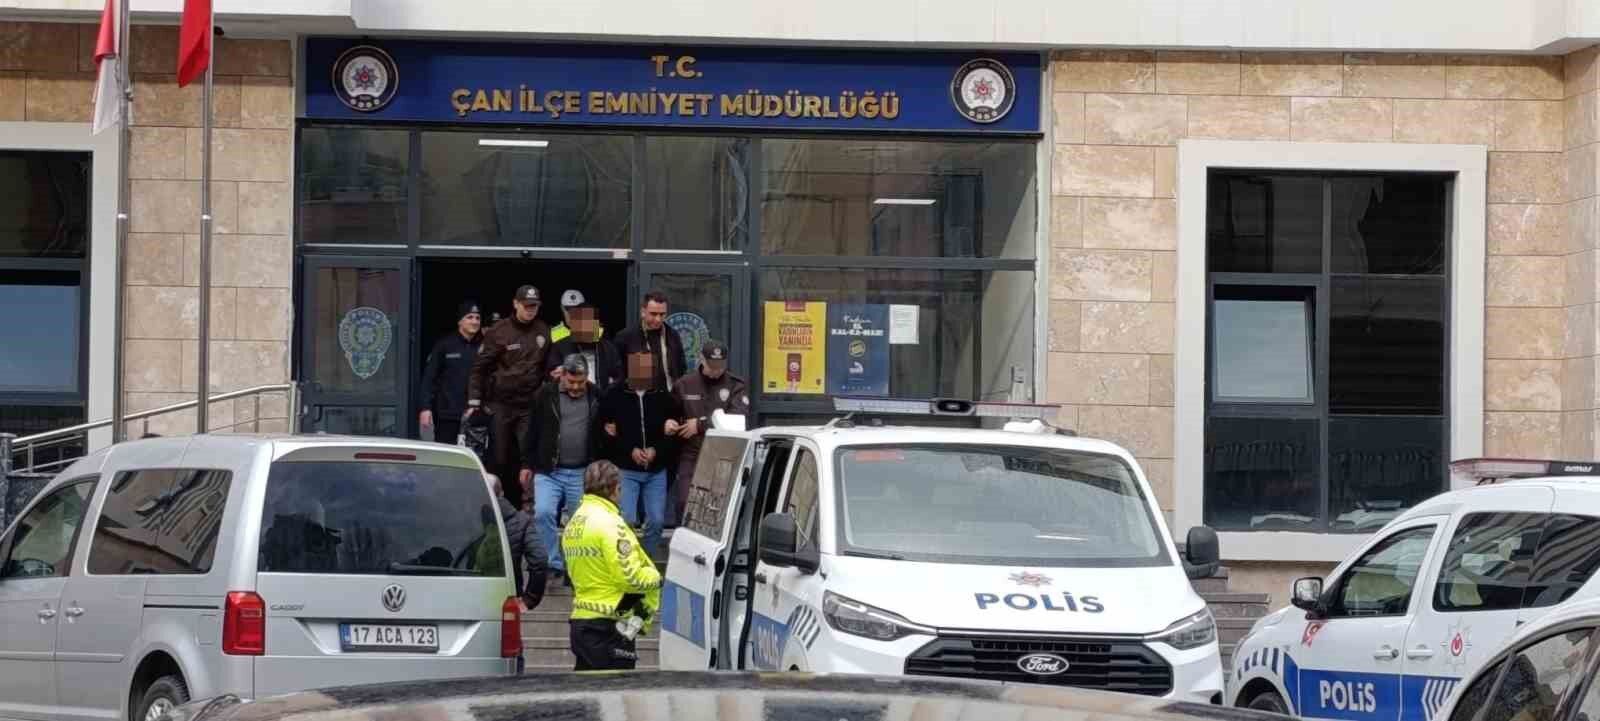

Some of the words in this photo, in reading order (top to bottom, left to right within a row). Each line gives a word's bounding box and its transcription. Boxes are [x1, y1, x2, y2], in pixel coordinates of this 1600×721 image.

[651, 55, 703, 78] T.C.
[451, 88, 512, 118] ÇAN
[519, 83, 582, 119] İLÇE
[588, 87, 714, 117] EMNİYET
[720, 89, 900, 120] MÜDÜRLÜĞÜ
[974, 591, 1105, 613] POLİS
[353, 627, 369, 643] 17
[376, 628, 402, 644] ACA
[409, 628, 435, 645] 123
[1025, 655, 1060, 672] Ford
[1319, 680, 1377, 713] POLİS
